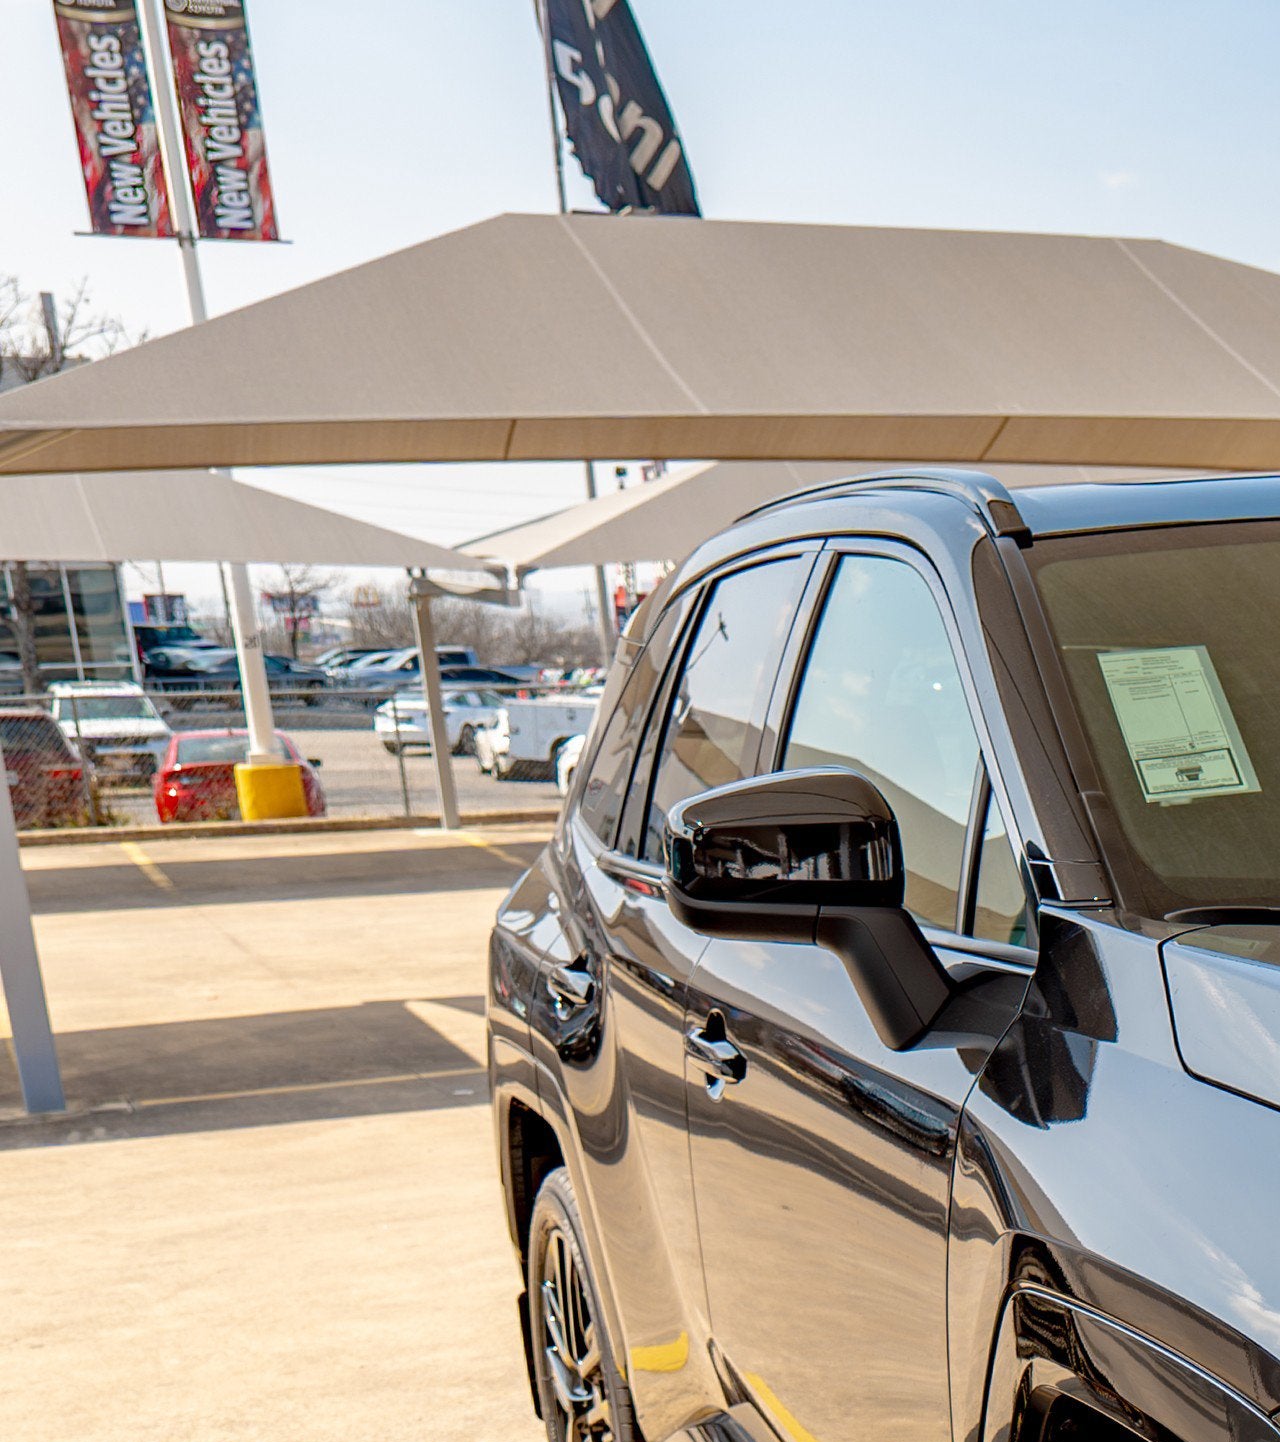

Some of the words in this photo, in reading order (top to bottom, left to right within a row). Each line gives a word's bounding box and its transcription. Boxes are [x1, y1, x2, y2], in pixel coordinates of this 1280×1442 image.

[84, 34, 139, 157] Vehicles
[193, 41, 244, 161] Vehicles
[109, 160, 150, 226] New
[214, 165, 255, 230] New
